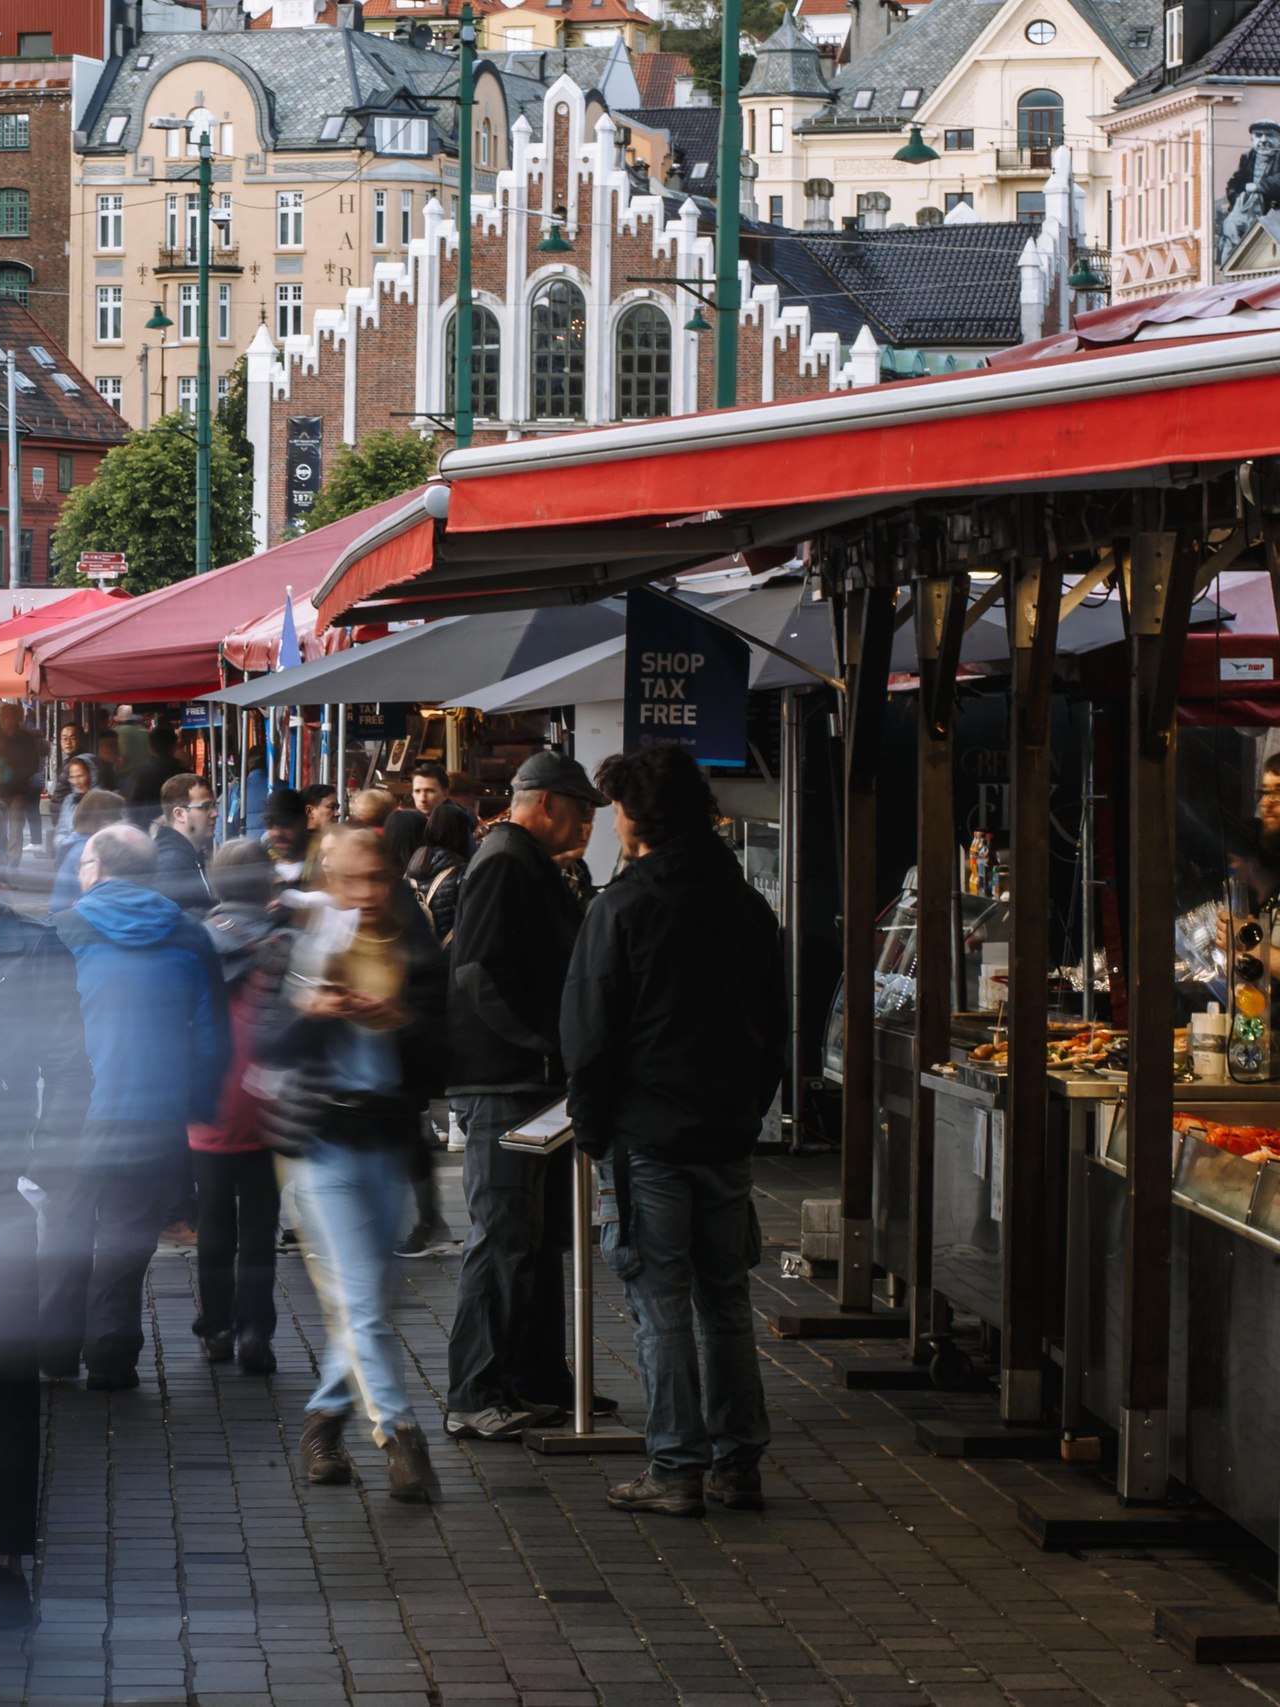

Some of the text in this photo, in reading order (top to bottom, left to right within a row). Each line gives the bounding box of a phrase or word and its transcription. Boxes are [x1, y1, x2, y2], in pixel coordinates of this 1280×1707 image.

[338, 194, 355, 310] HAR
[641, 652, 705, 674] SHOP
[640, 678, 686, 699] TAX
[185, 707, 206, 716] FREE
[359, 715, 384, 725] FREE
[640, 703, 698, 725] FREE
[680, 737, 697, 746] Blue
